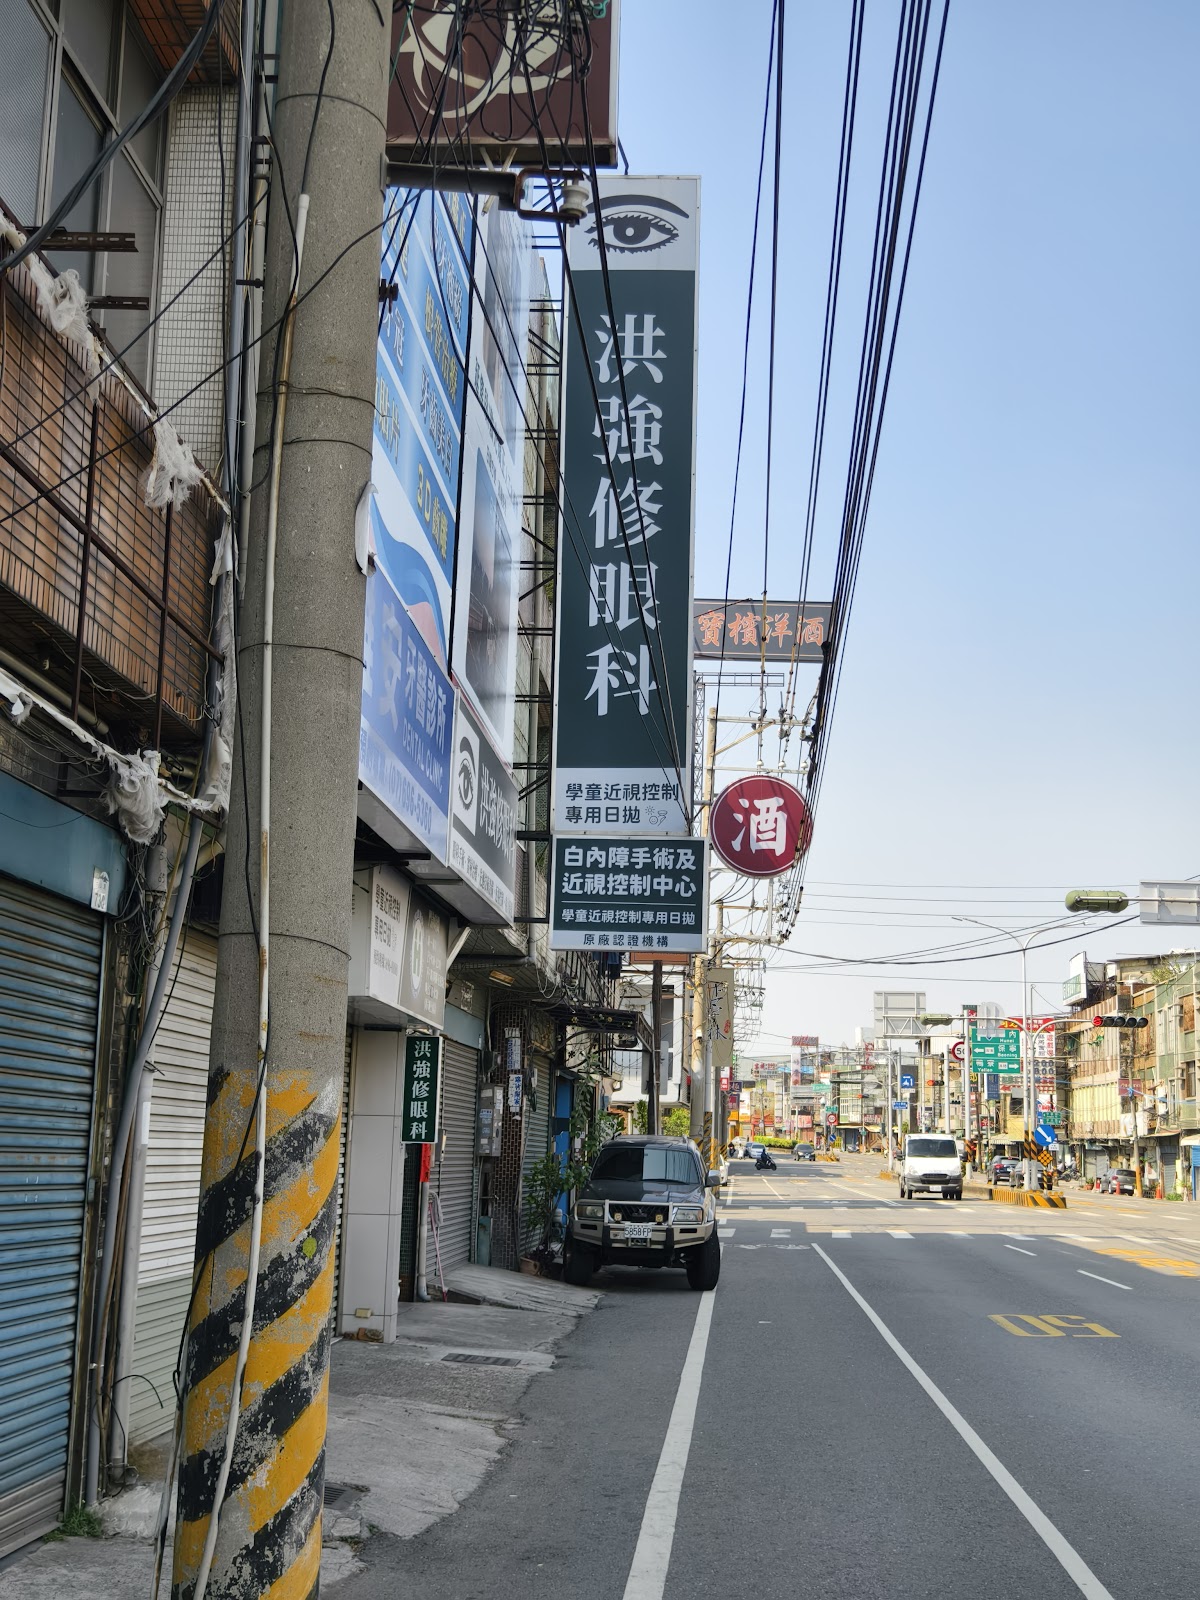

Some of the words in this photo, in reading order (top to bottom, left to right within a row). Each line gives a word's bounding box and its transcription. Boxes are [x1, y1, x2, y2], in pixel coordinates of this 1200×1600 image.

[585, 312, 667, 717] 洪強修眼科
[402, 721, 425, 770] DENTAL
[565, 783, 679, 802] 學童近視控制
[731, 796, 788, 857] 酒
[564, 845, 697, 870] 白內障手術及
[561, 872, 697, 897] 近視控制中心
[583, 933, 669, 948] 原廠認證機構
[409, 1040, 432, 1140] 洪強修眼科
